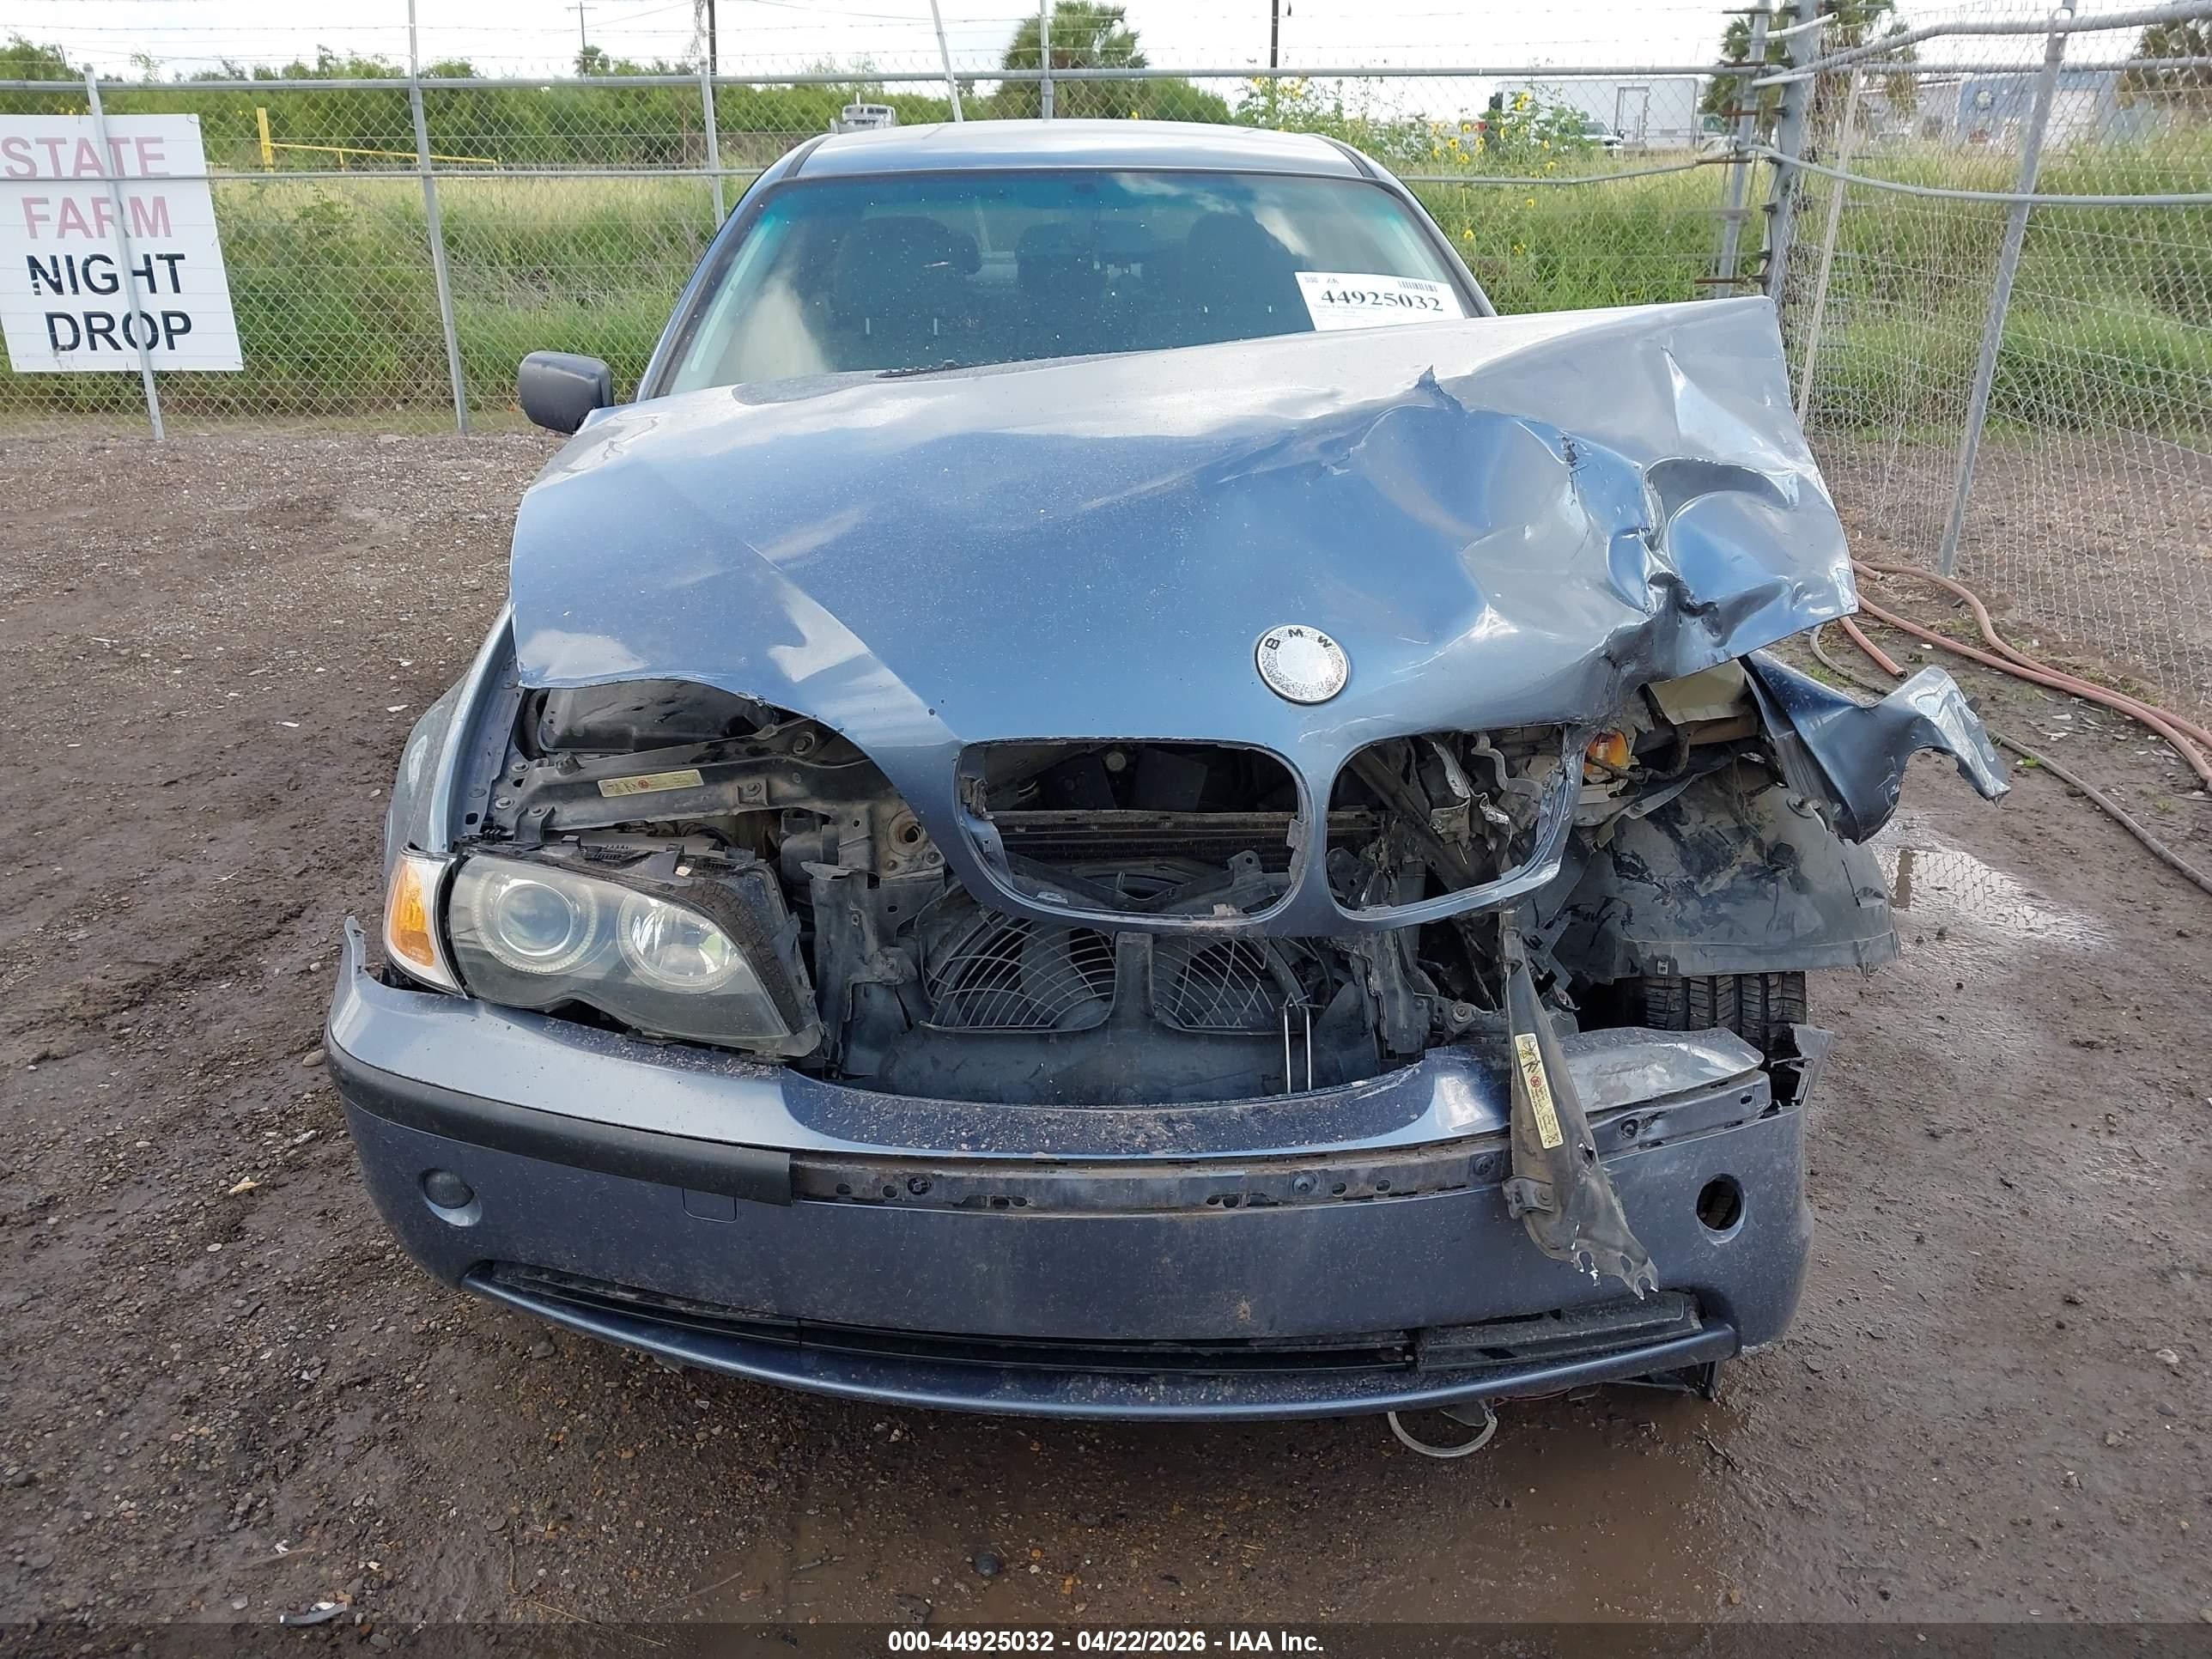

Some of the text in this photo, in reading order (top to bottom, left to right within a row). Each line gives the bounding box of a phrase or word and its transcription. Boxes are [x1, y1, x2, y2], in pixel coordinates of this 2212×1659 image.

[0, 137, 170, 179] STATE
[21, 197, 172, 239] FARM
[26, 253, 185, 295] NIGHT
[1321, 289, 1444, 312] 44925032
[45, 310, 191, 351] DROP
